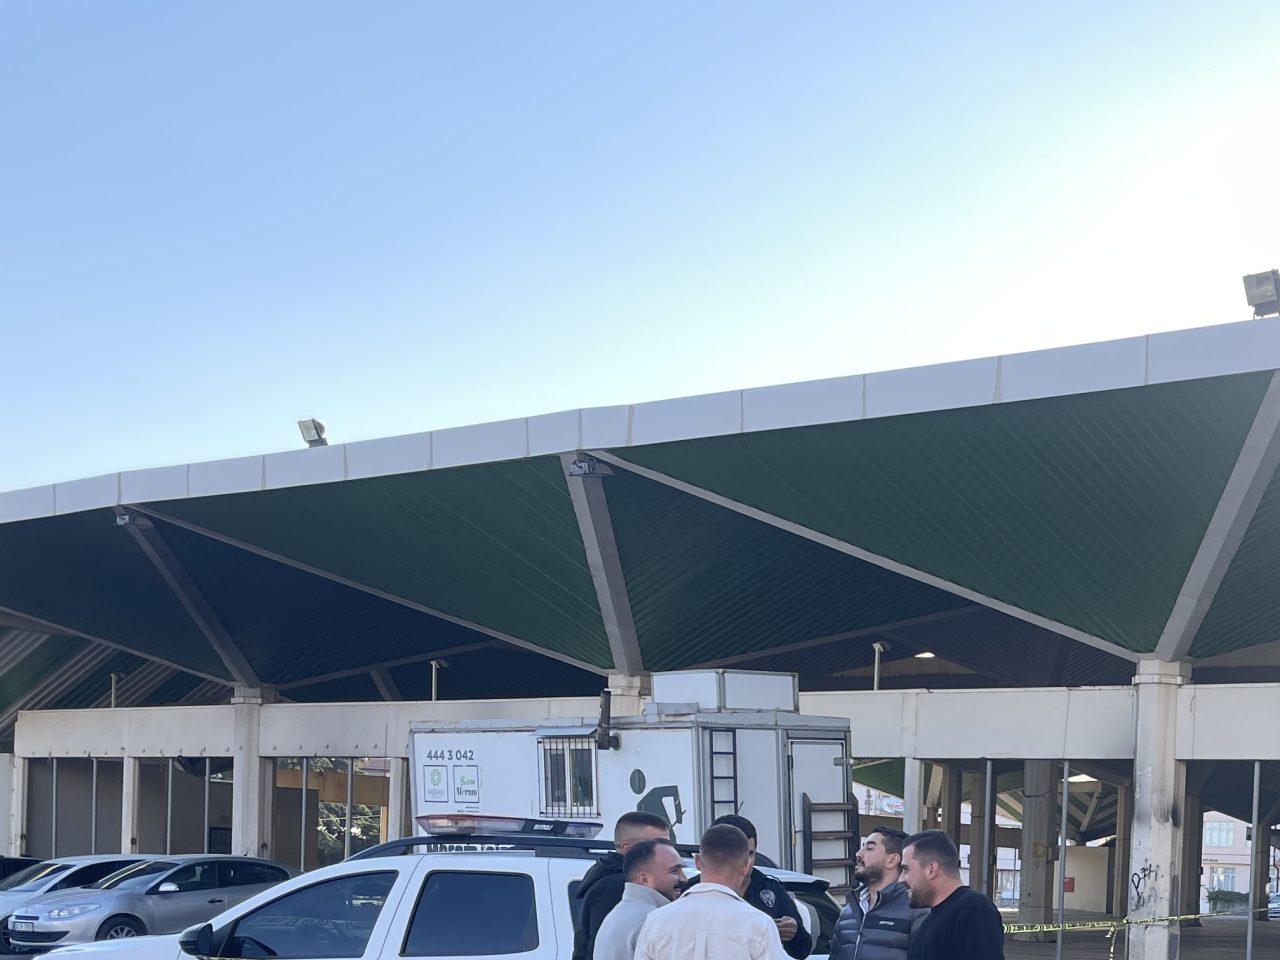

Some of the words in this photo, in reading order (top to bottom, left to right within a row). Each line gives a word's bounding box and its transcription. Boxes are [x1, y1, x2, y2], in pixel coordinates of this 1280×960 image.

[427, 750, 445, 760] 444
[447, 750, 453, 760] 3
[455, 750, 474, 760] 042
